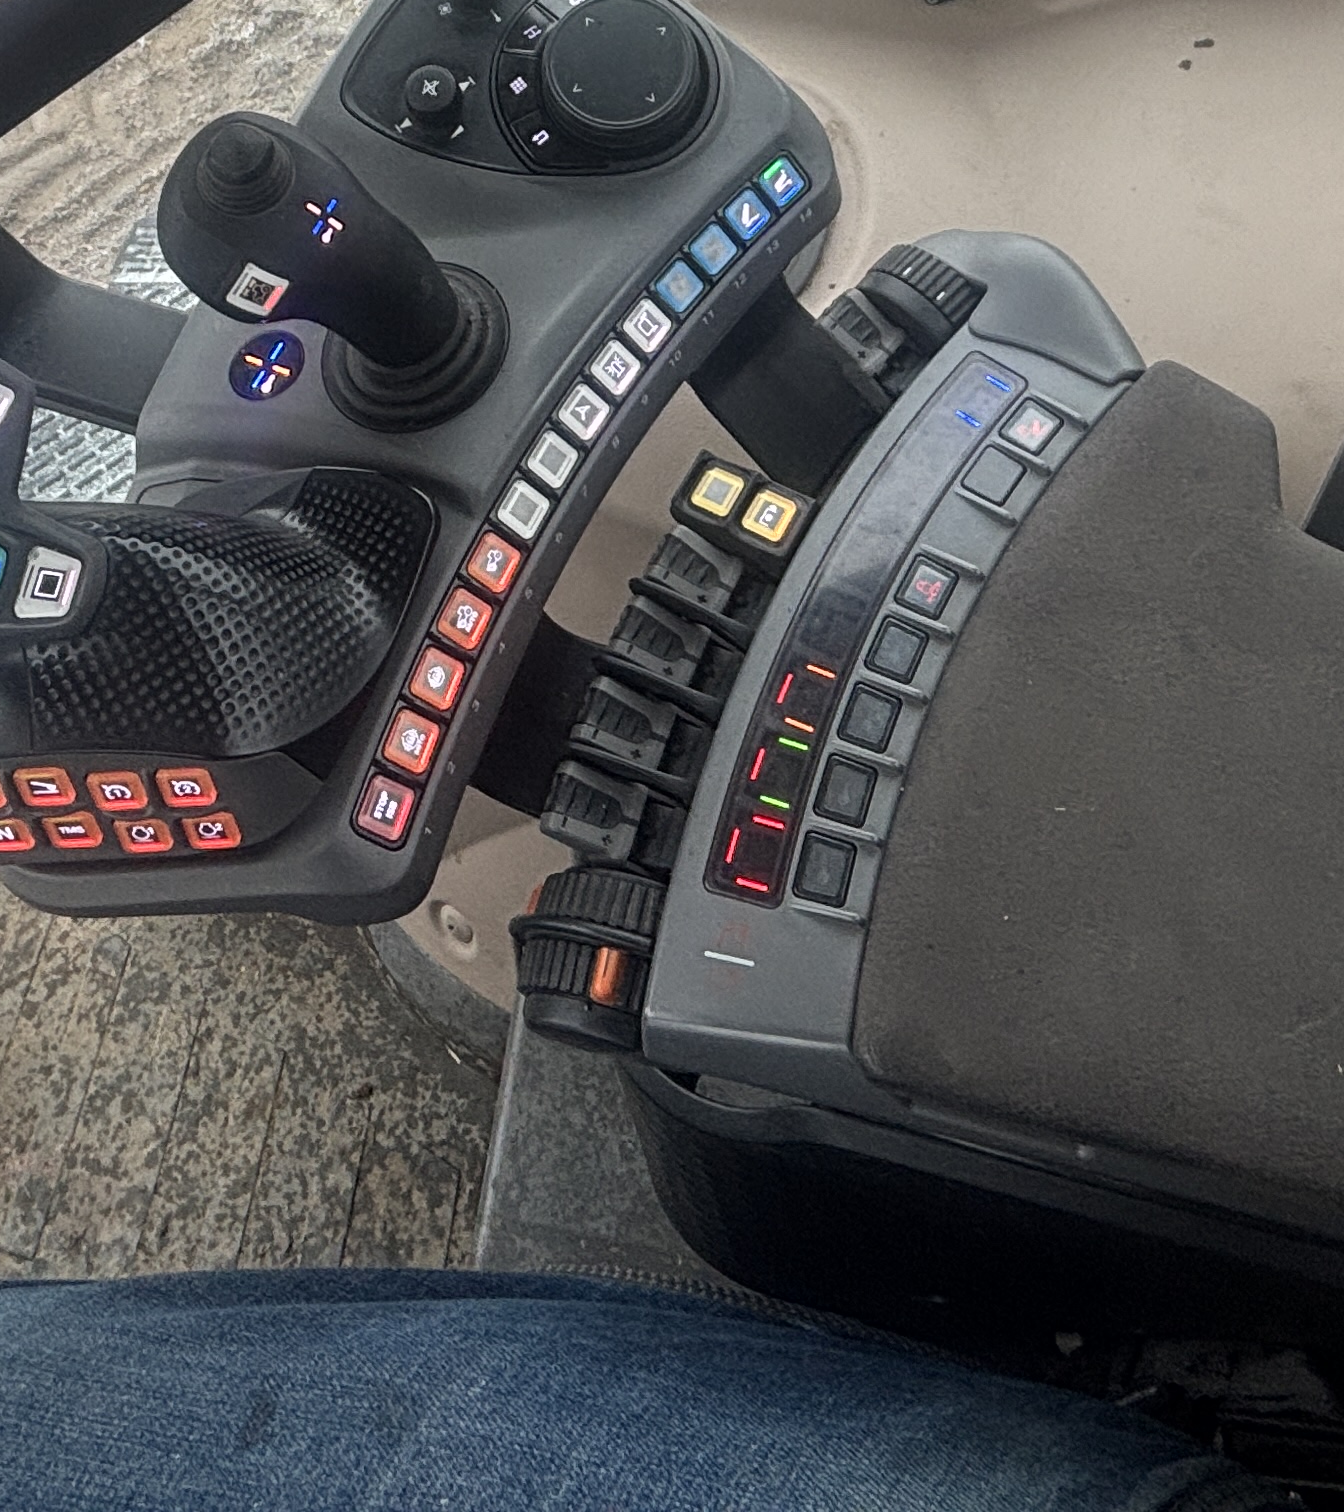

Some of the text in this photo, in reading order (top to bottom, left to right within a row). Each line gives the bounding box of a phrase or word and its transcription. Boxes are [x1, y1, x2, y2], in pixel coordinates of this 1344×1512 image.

[668, 349, 683, 367] 10
[373, 790, 389, 820] STOP
[58, 825, 86, 836] TMS
